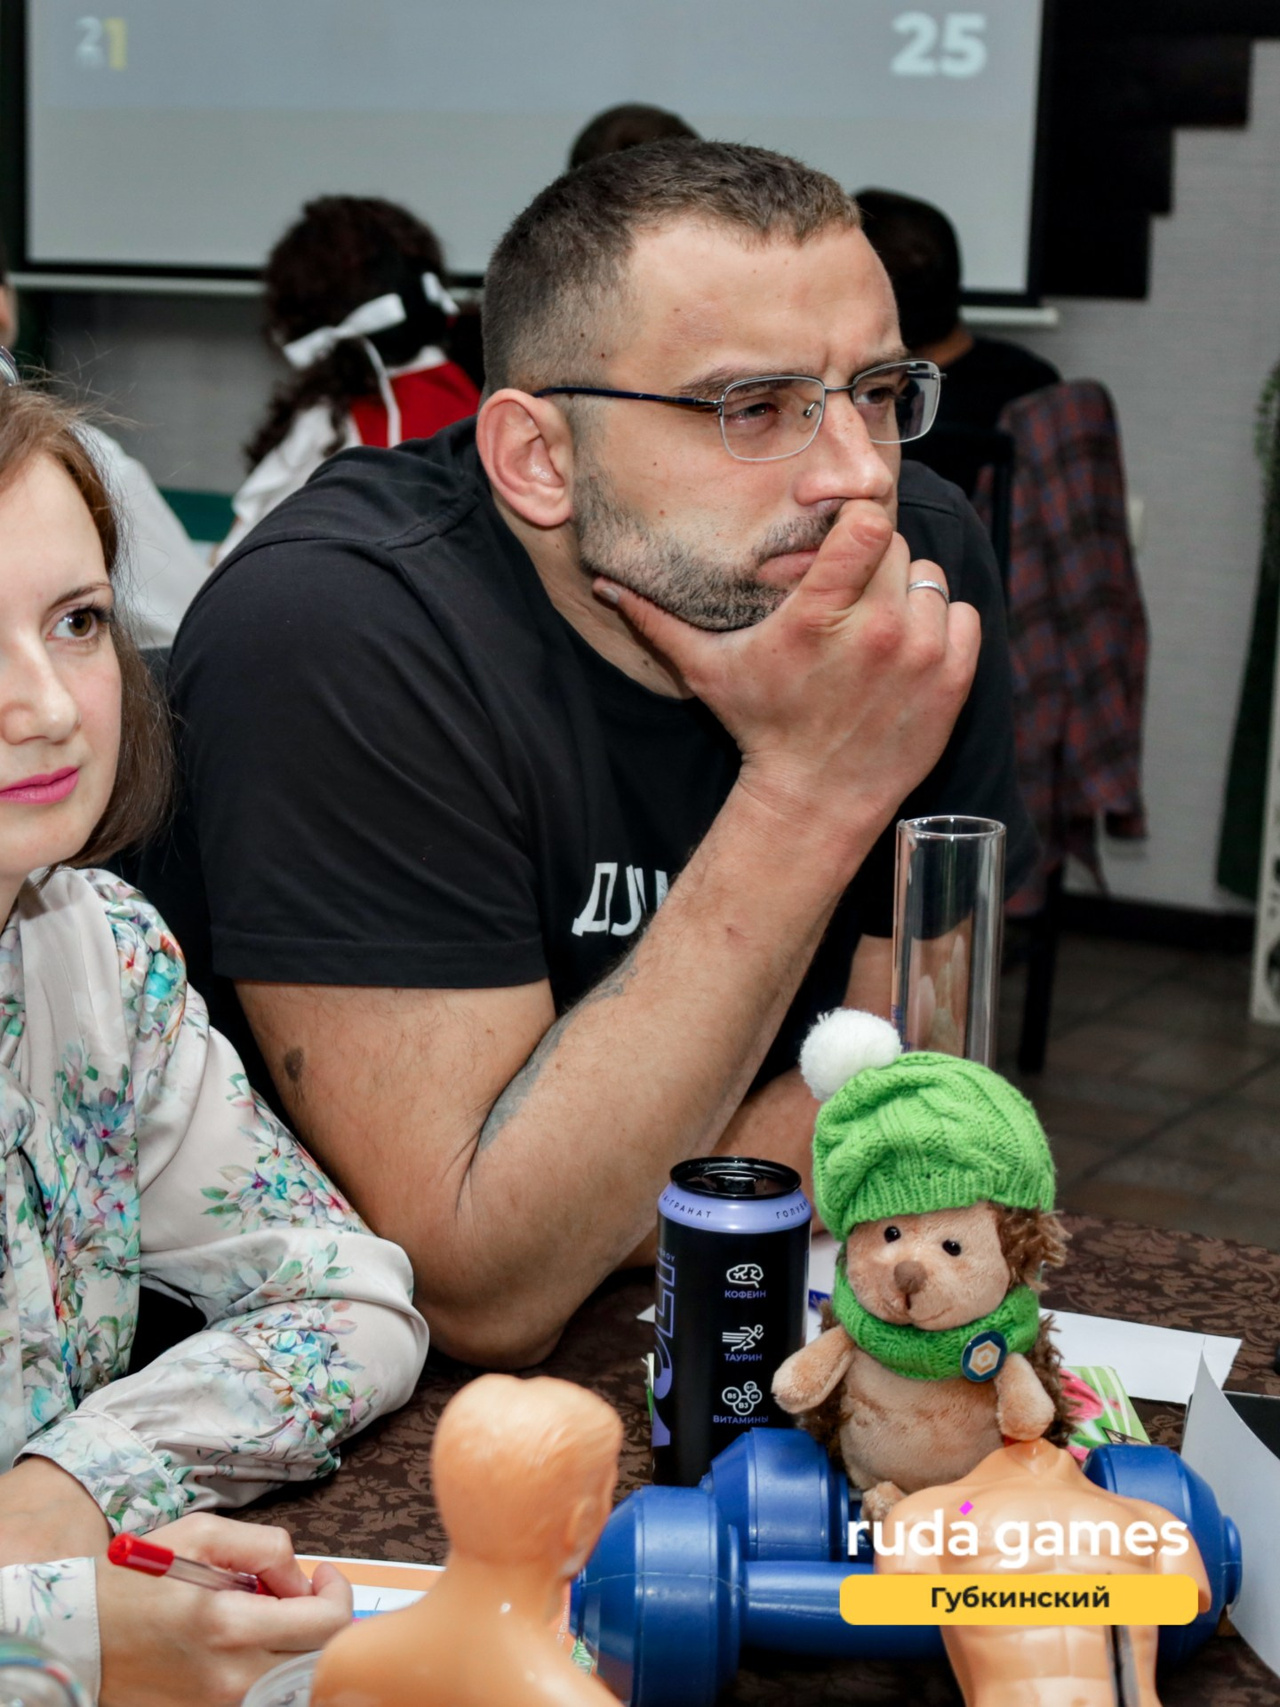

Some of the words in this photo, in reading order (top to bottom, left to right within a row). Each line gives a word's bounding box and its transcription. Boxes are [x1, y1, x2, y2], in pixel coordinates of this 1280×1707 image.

[891, 12, 987, 77] 25
[724, 1290, 767, 1299] КОФЕИН
[724, 1353, 763, 1362] ТАУРИН
[713, 1415, 769, 1424] ВИТАМИНЫ
